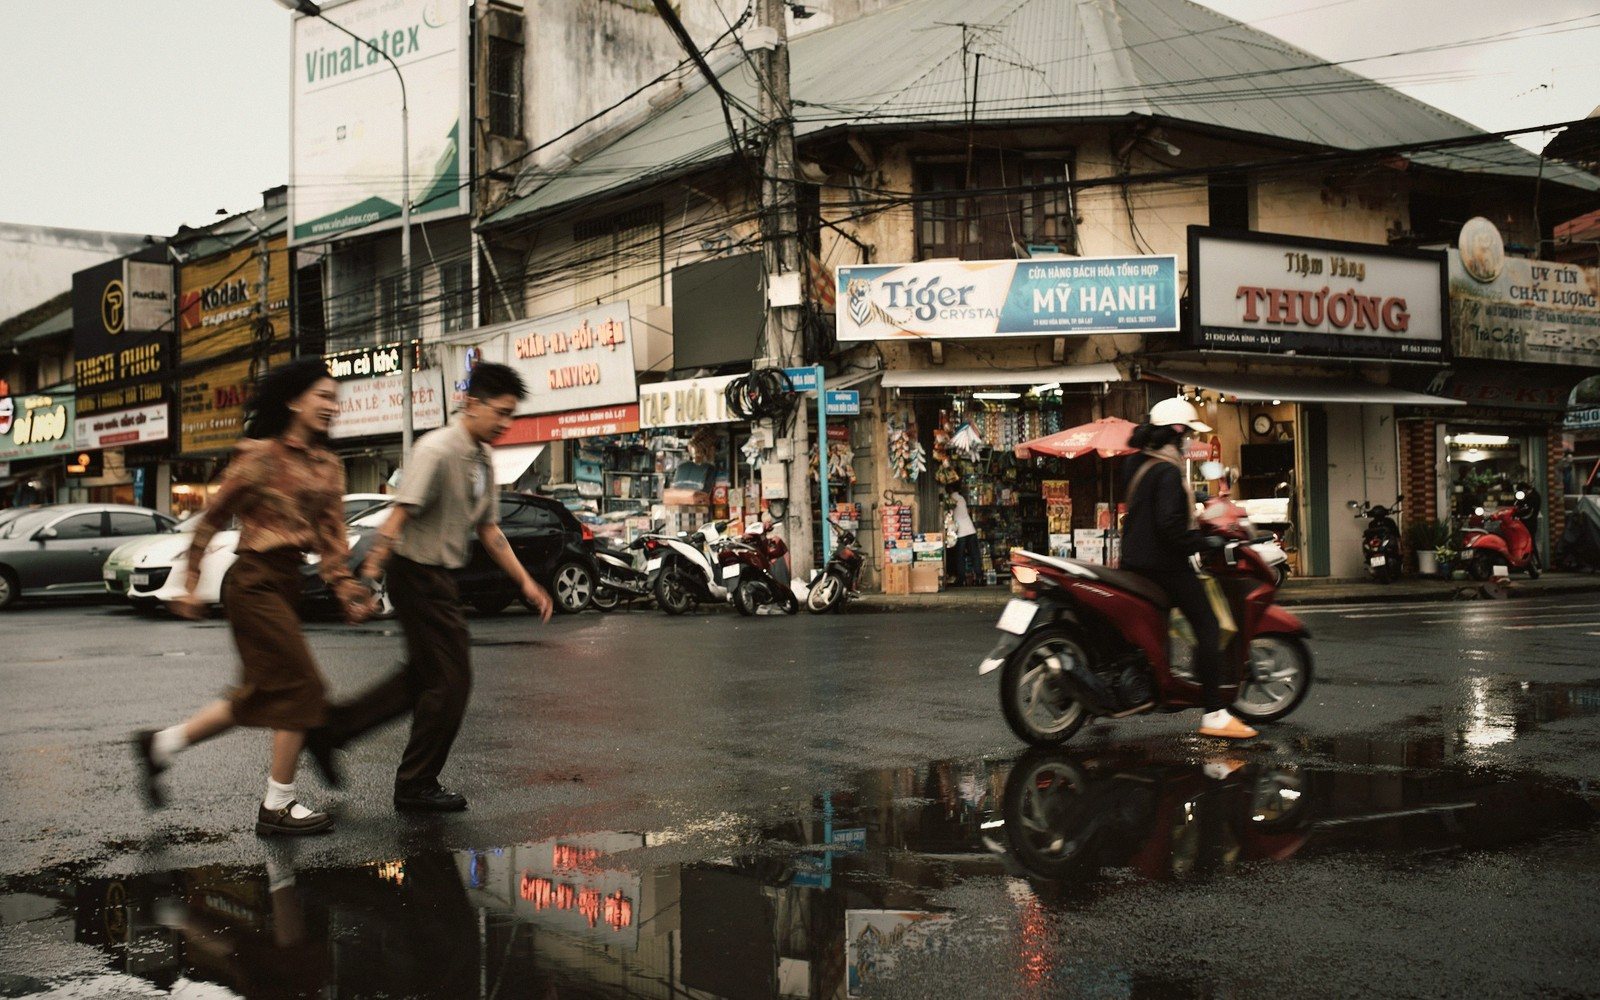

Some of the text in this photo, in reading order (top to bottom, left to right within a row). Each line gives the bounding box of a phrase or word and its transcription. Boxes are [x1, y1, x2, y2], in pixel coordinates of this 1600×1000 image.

[305, 25, 421, 84] VinaLatex
[1048, 264, 1072, 279] HÀNG
[1073, 264, 1096, 278] BÁCH
[1531, 266, 1578, 284] UY TÍN
[201, 277, 250, 311] Kodak
[882, 276, 975, 322] Tiger
[1033, 282, 1156, 317] MỸ HẠNH
[1509, 282, 1549, 302] CHẤT
[940, 308, 1002, 321] CRYSTAL
[1236, 285, 1411, 333] THƯƠNG
[1213, 333, 1226, 342] KHU
